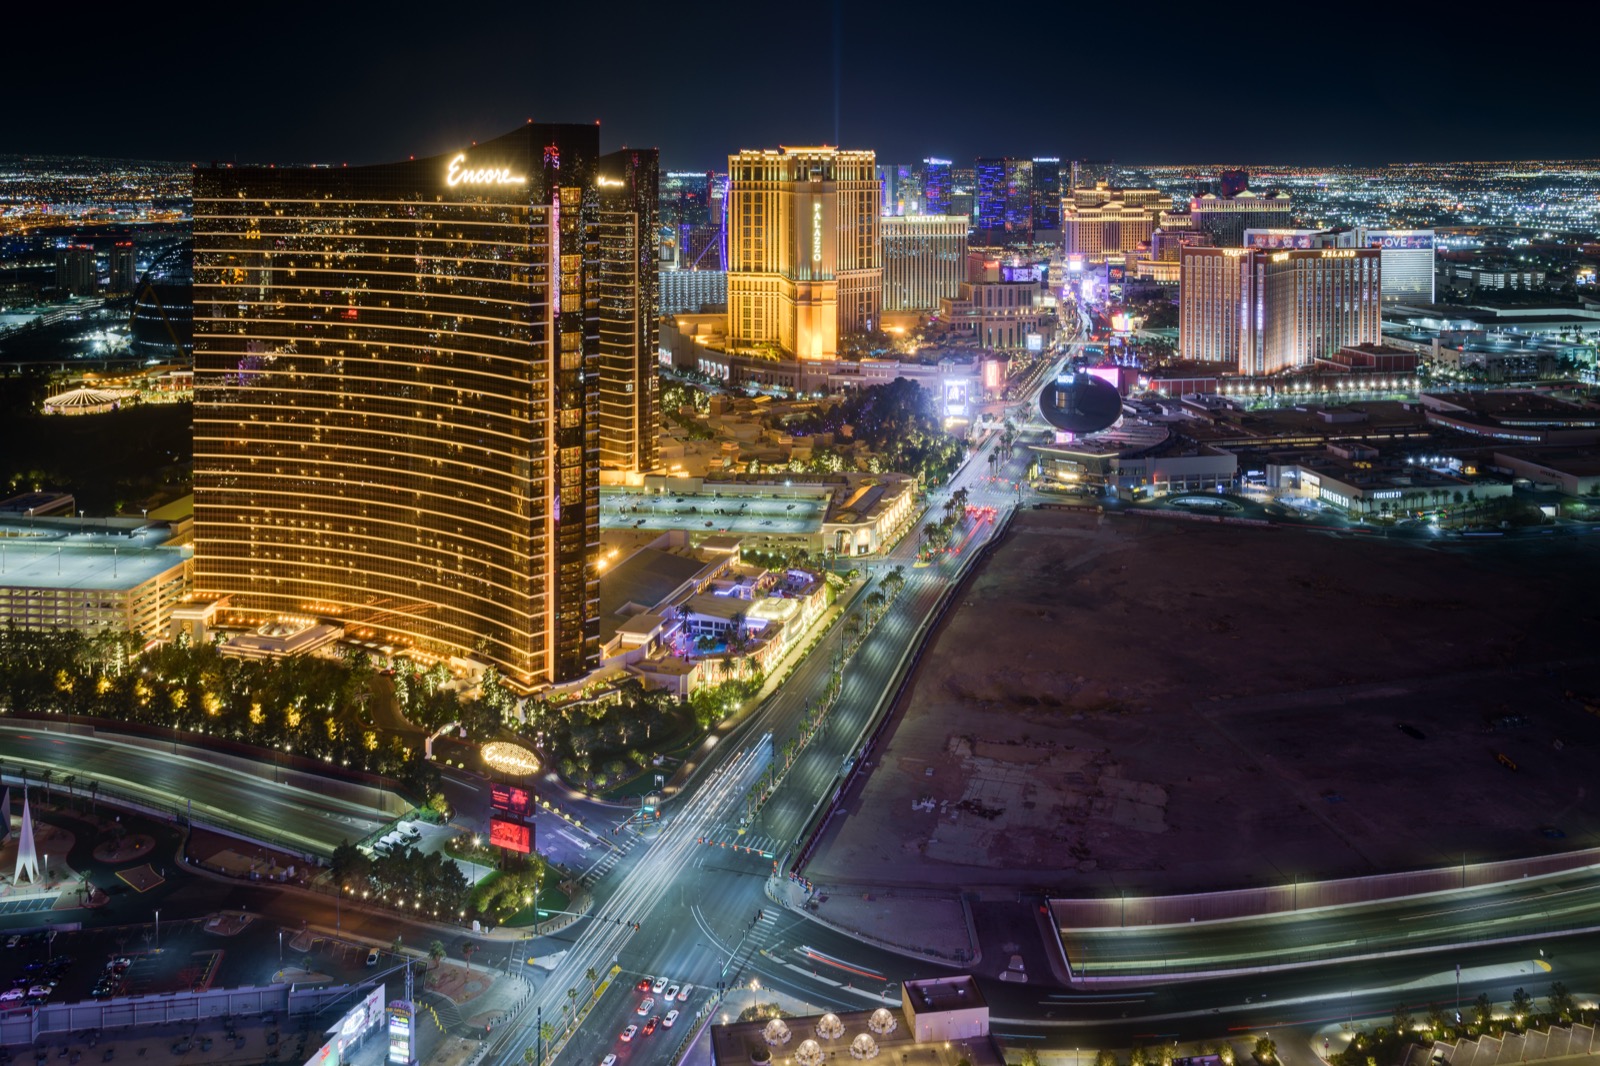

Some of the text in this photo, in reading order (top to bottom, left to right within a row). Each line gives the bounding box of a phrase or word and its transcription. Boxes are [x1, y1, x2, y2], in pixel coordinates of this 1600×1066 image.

[446, 153, 527, 187] Encore
[813, 203, 821, 262] PALAZZO
[1379, 237, 1407, 248] LOVE
[1321, 250, 1356, 258] ISLAND
[1320, 488, 1349, 508] FOREVER 21
[1373, 491, 1395, 499] FOREVER
[484, 746, 539, 770] Encore
